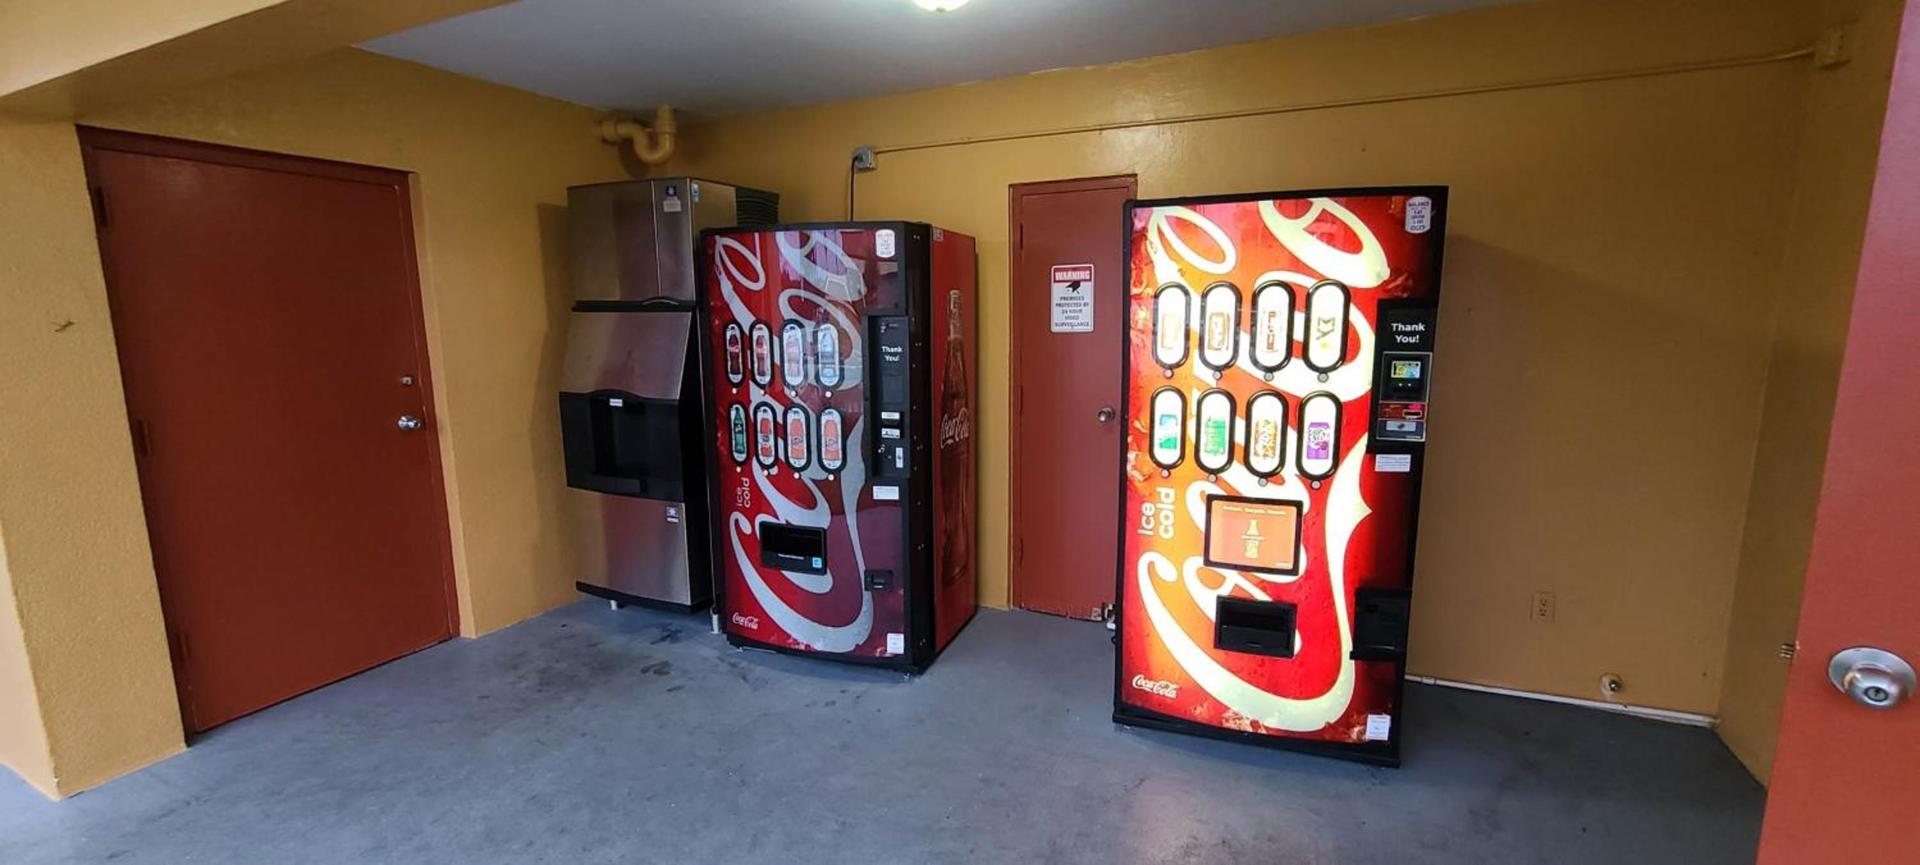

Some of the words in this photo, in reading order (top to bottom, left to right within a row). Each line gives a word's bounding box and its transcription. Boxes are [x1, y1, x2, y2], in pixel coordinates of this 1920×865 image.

[1055, 270, 1090, 281] WARNING
[1391, 322, 1426, 332] Thank
[1395, 335, 1420, 343] You!
[881, 345, 902, 353] Thank
[741, 477, 751, 508] cold
[1156, 487, 1176, 539] cold
[1132, 674, 1180, 699] Coca-Cola
